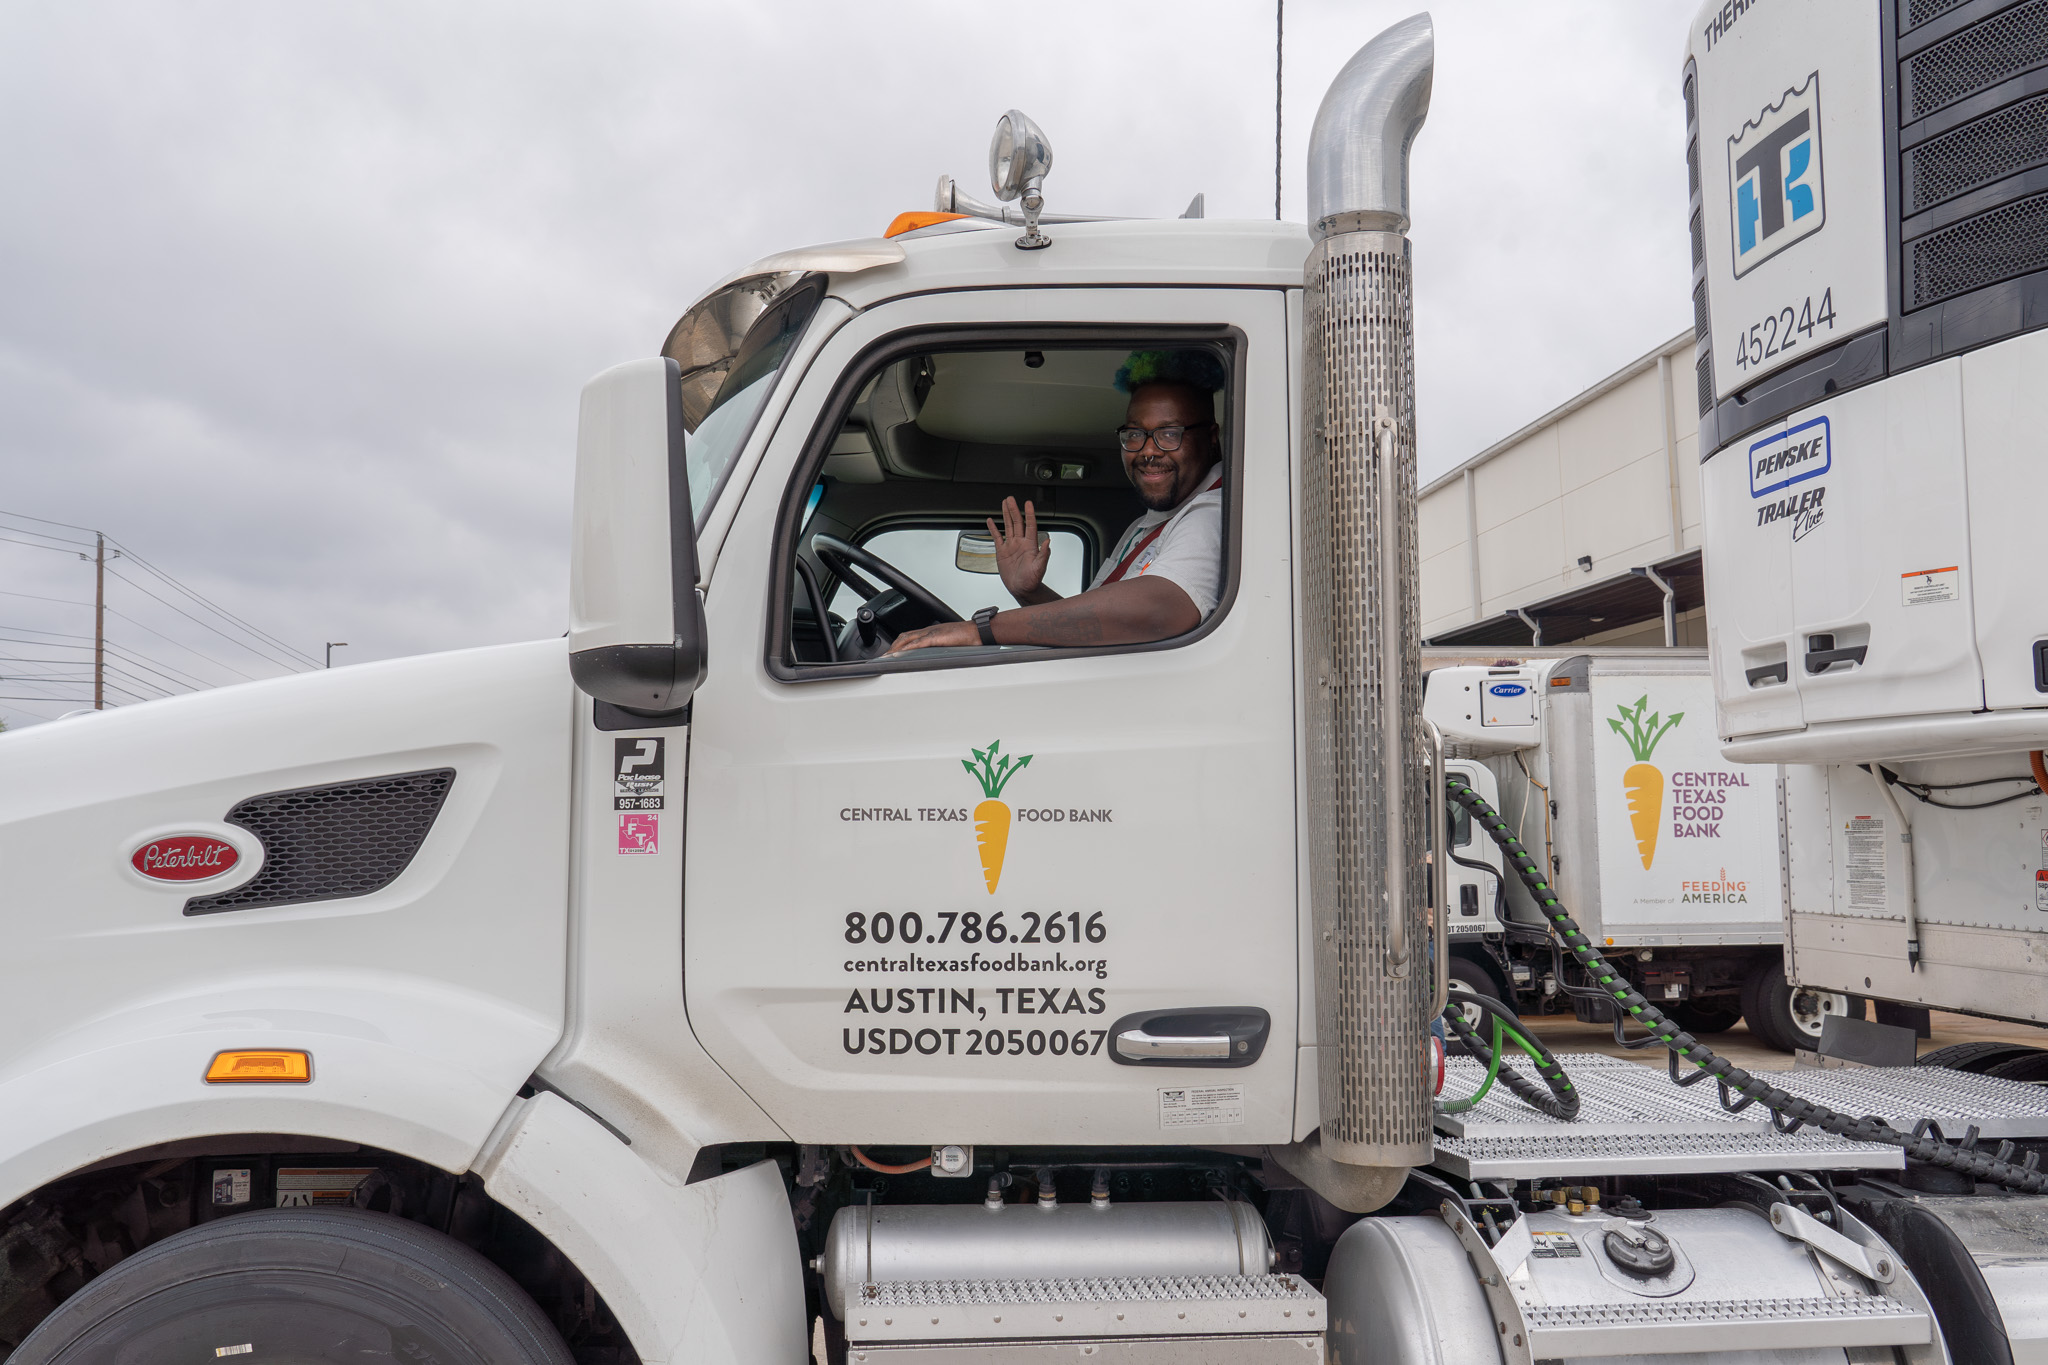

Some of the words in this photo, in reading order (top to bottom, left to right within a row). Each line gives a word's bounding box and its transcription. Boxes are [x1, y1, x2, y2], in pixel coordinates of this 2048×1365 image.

[1736, 287, 1837, 371] 452244
[1755, 436, 1824, 480] PENSKE
[1757, 486, 1826, 527] TRAILER
[1493, 686, 1523, 694] Carrier
[1672, 772, 1749, 787] CENTRAL
[619, 798, 661, 810] 957-1683
[1673, 789, 1726, 804] TEXAS
[840, 807, 912, 822] CENTRAL
[918, 807, 968, 822] TEXAS
[1017, 808, 1066, 822] FOOD
[1069, 808, 1113, 823] BANK
[1673, 806, 1724, 821] FOOD
[1673, 823, 1721, 838] BANK
[143, 844, 230, 872] Peterbilt
[1682, 881, 1746, 894] FEEDING
[1681, 893, 1748, 904] AMERICA
[843, 910, 1108, 945] 800.786.2616
[1456, 924, 1486, 933] 2050067
[843, 952, 1108, 980] centraltexasfoodbank.org
[843, 987, 987, 1022] AUSTIN,
[995, 987, 1107, 1015] TEXAS
[843, 1027, 961, 1056] USDOT
[965, 1029, 1108, 1057] 2050067
